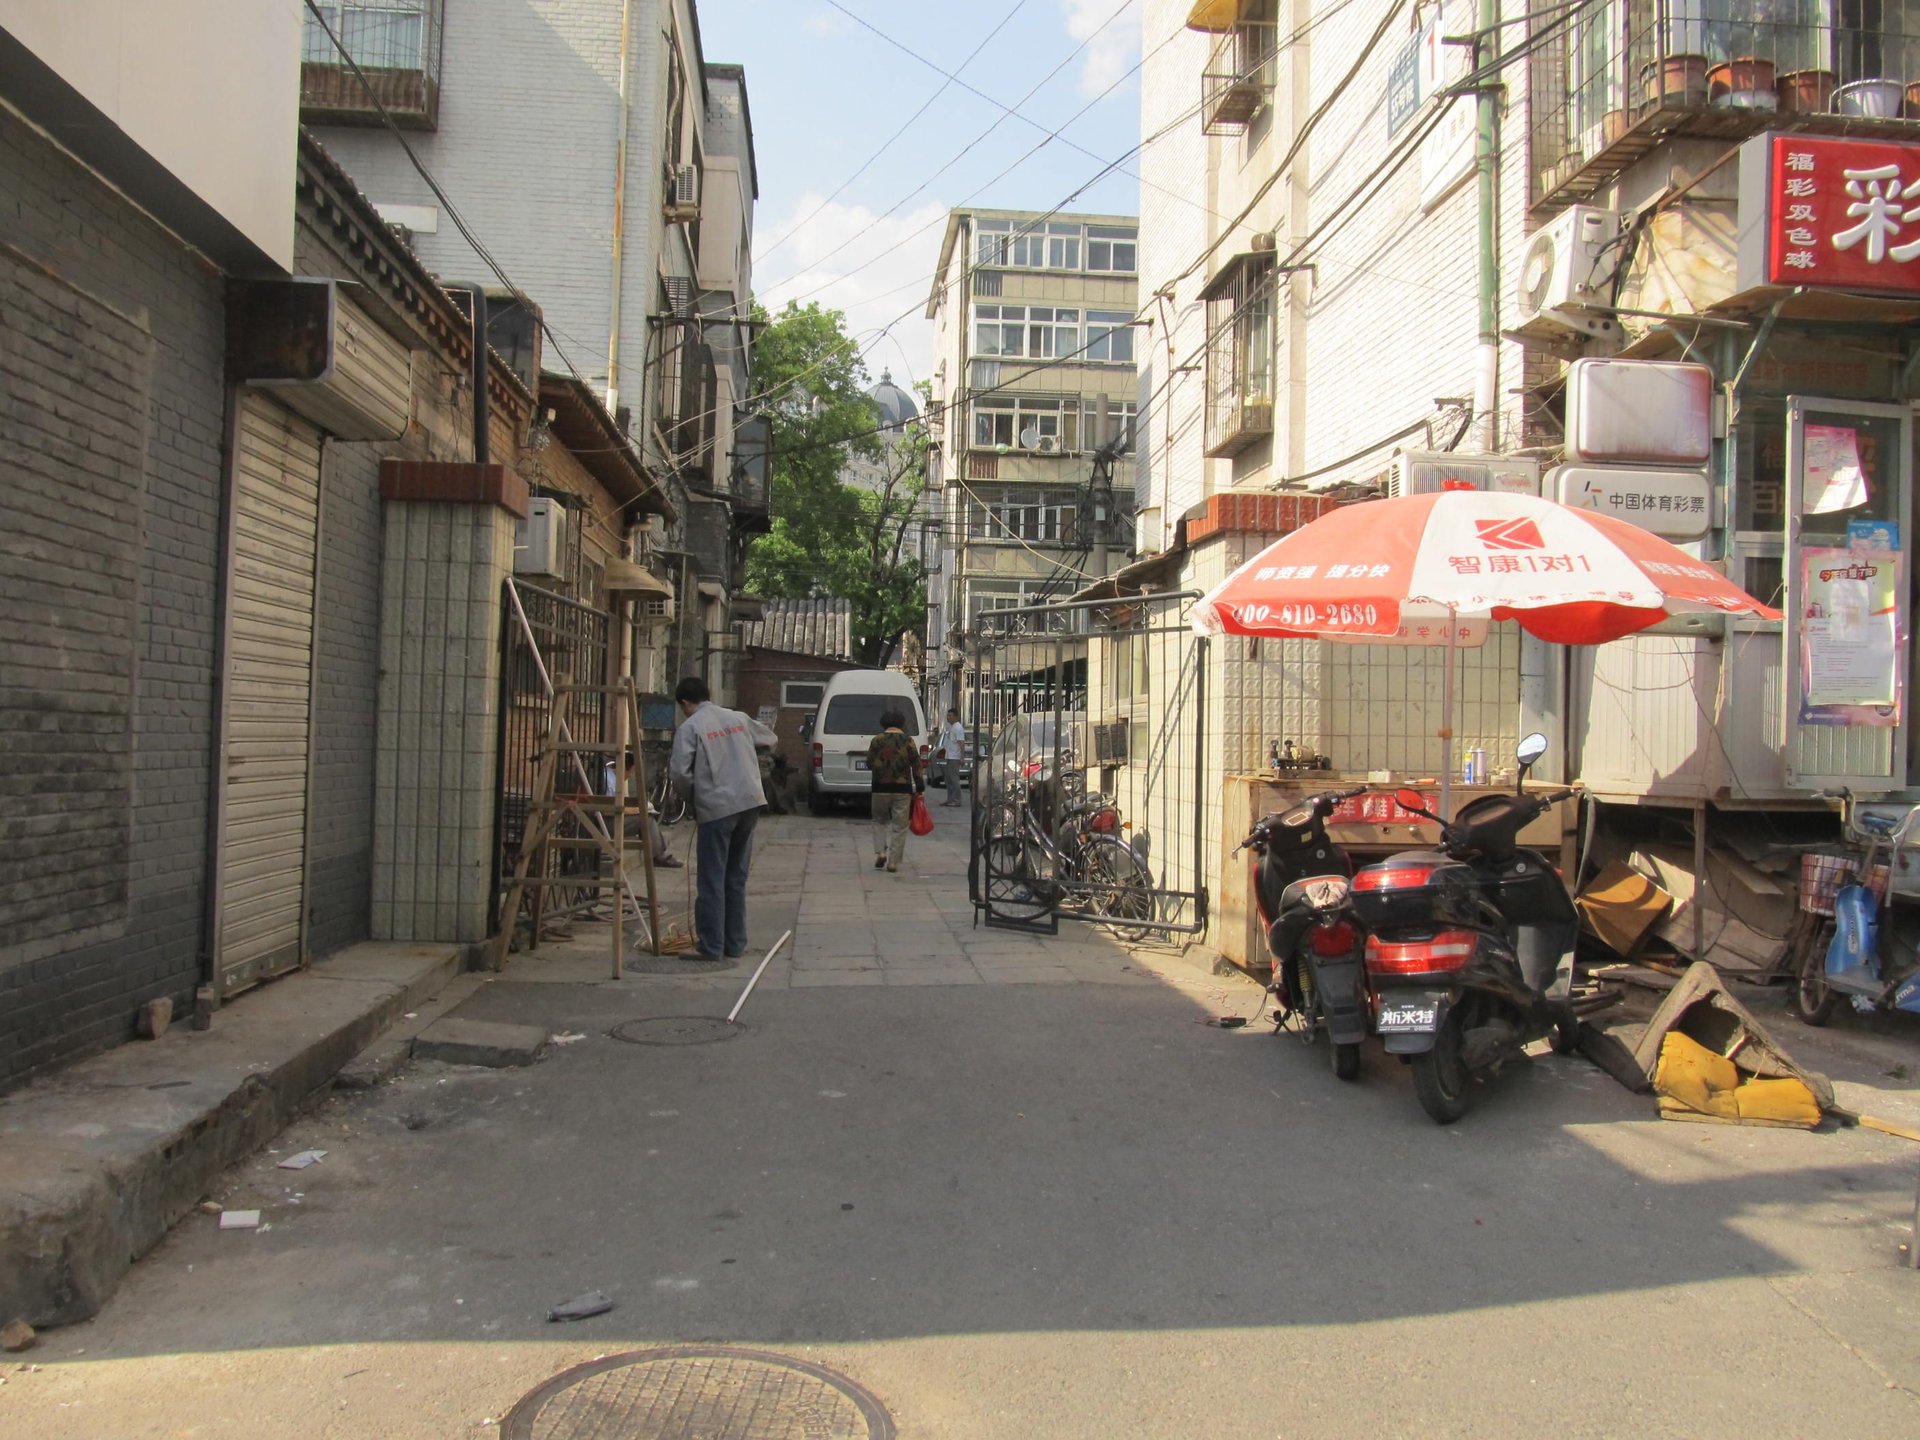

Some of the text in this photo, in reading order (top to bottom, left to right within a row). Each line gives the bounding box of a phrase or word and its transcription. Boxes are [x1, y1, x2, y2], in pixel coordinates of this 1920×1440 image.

[1784, 152, 1817, 268] 福彩双色球
[1832, 164, 1920, 264] 彩
[1609, 492, 1705, 513] 中国体育彩票
[1448, 554, 1592, 575] 智康1对1
[1380, 1009, 1434, 1025] 斯米特
